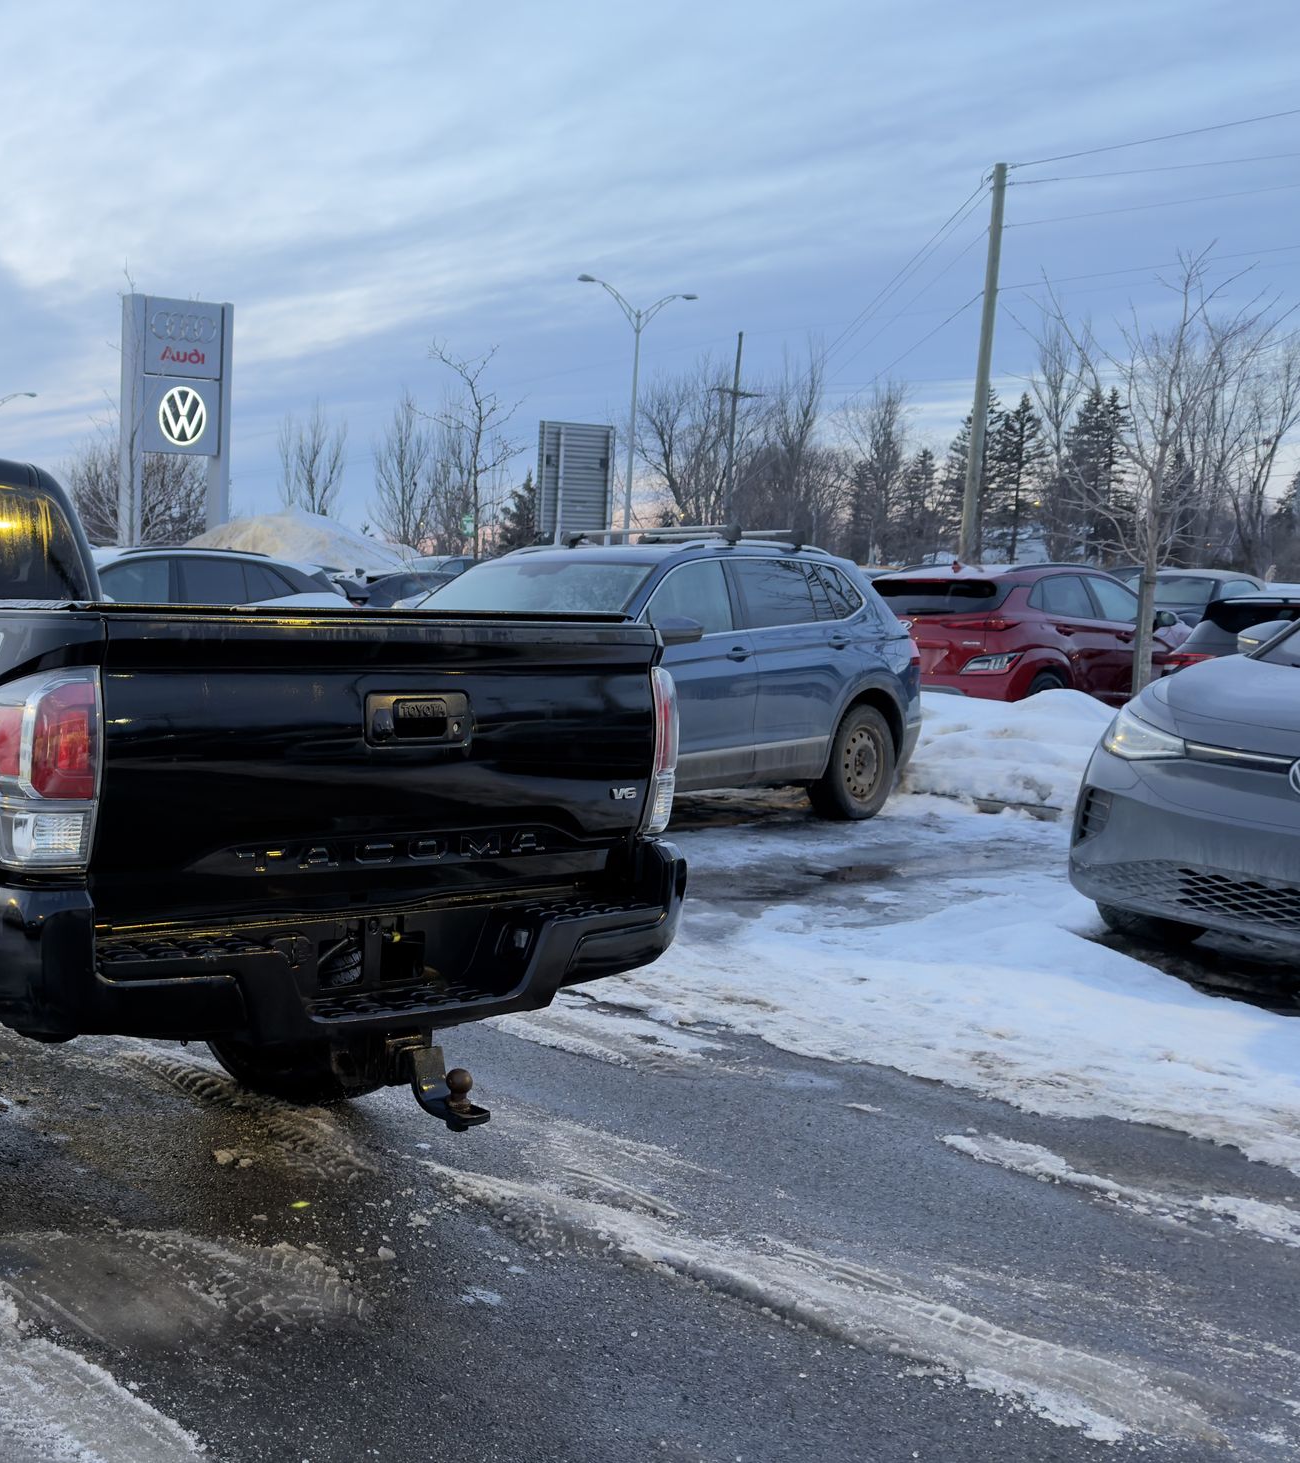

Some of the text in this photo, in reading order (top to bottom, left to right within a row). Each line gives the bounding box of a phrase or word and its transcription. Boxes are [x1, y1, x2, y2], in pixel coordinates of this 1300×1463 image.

[160, 346, 205, 364] Audi
[160, 387, 206, 444] VW
[400, 703, 446, 717] TOYOTA
[611, 786, 637, 800] V6
[235, 830, 546, 873] TACOMA
